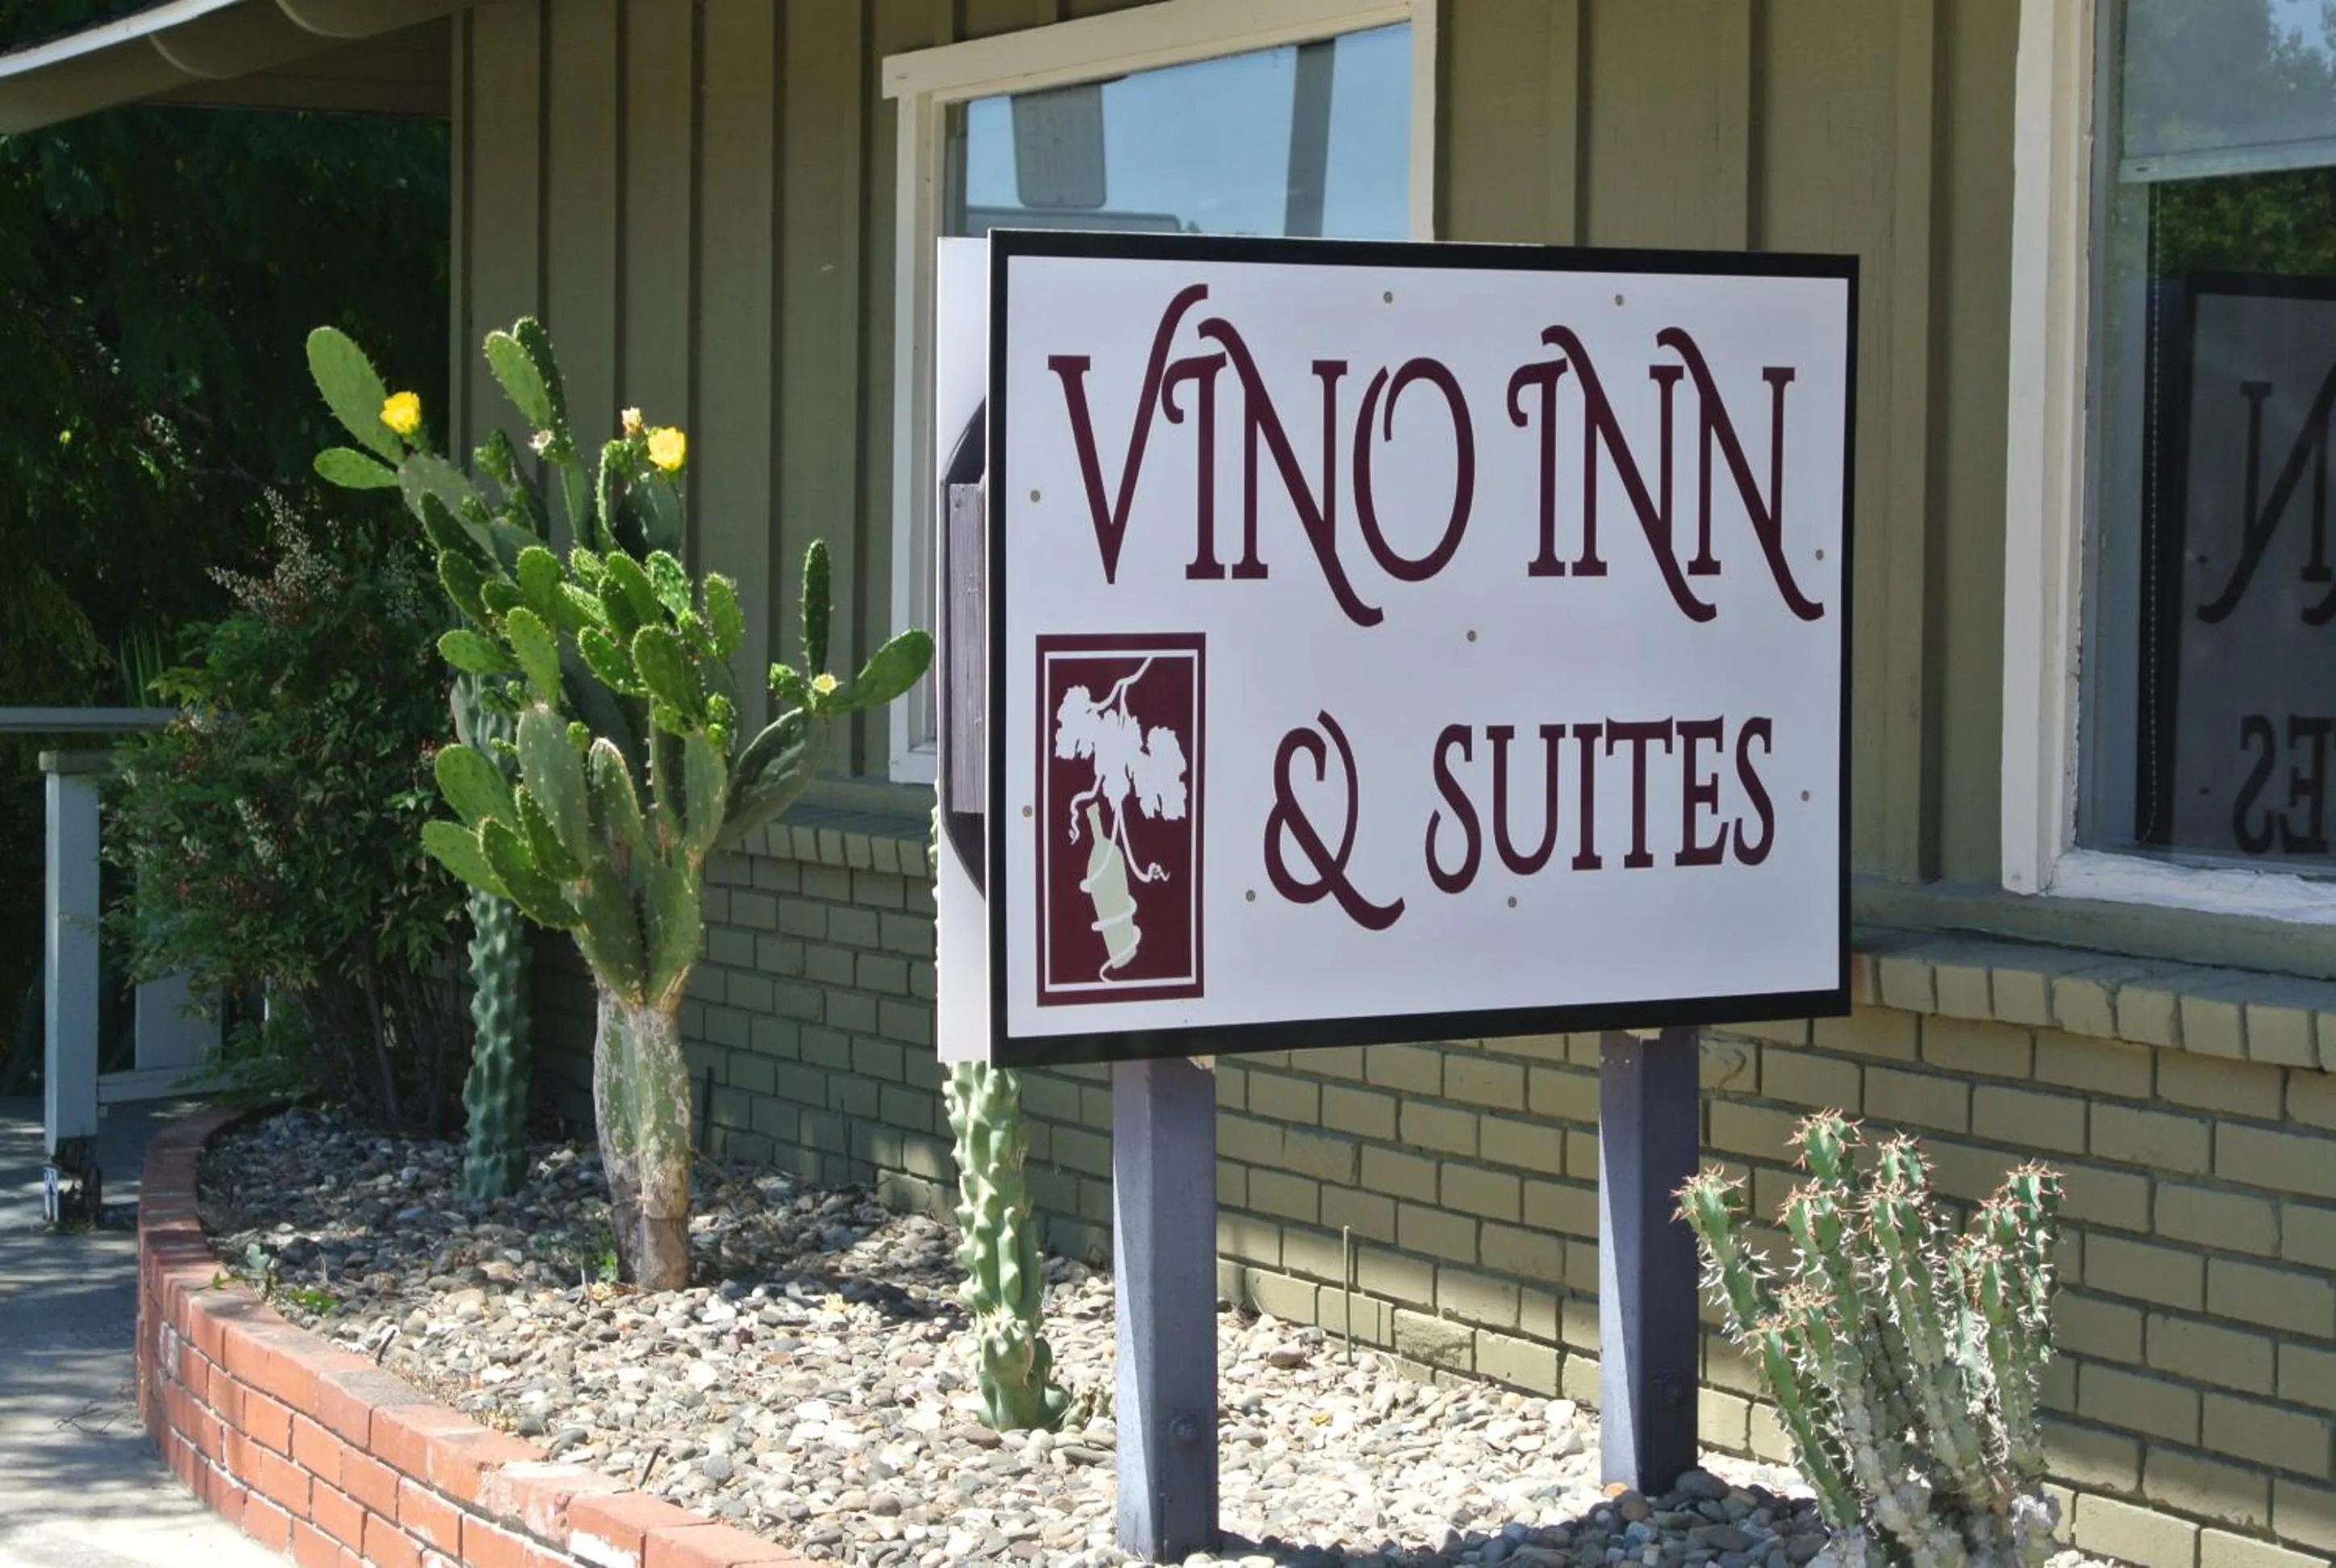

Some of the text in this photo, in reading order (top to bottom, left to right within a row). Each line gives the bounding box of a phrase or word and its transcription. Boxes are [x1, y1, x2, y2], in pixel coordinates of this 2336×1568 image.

[1048, 284, 1475, 628] VINO
[1507, 325, 1825, 623] INN
[1264, 710, 1775, 932] & SUITES
